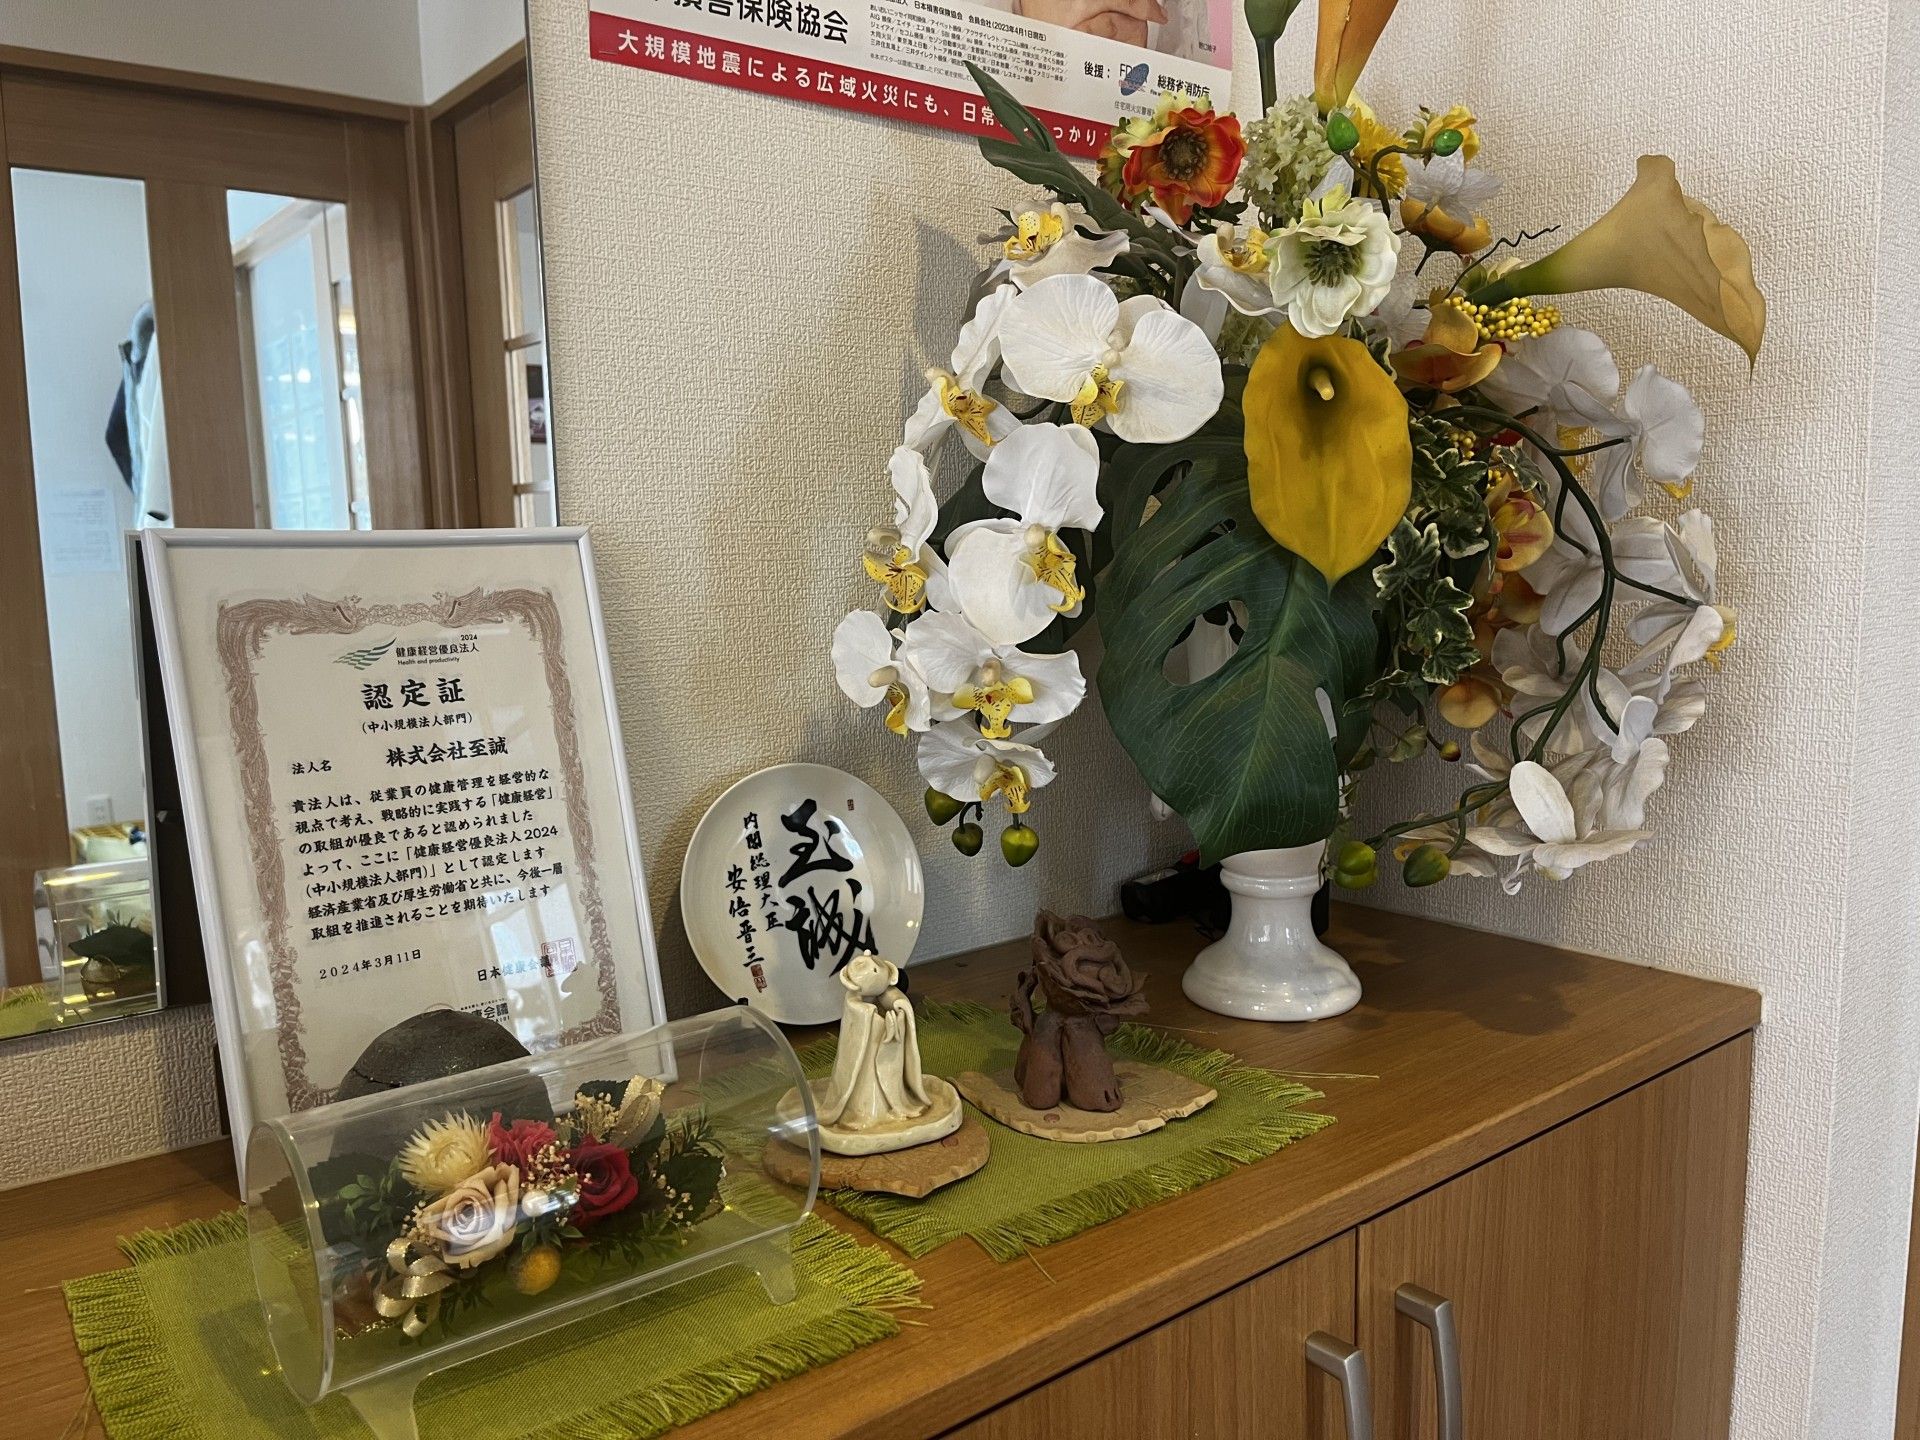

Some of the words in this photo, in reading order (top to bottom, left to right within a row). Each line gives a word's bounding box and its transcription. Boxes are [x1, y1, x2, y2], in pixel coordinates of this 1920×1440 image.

[395, 642, 480, 658] 健康経営優良法人
[397, 658, 416, 666] Health
[417, 657, 427, 665] and
[429, 656, 460, 665] productivity
[360, 677, 466, 710] 認定証
[362, 711, 473, 734] (中小規模法人部門)
[291, 758, 332, 775] 法人名
[385, 735, 509, 768] 株式会社至誠
[291, 768, 549, 814] 貴法人は、従業員の健康管理を経営的な
[299, 809, 533, 855] の取組が優良であると認められました
[725, 864, 765, 968] 安倍晋三
[319, 948, 422, 980] 2024年3月11日
